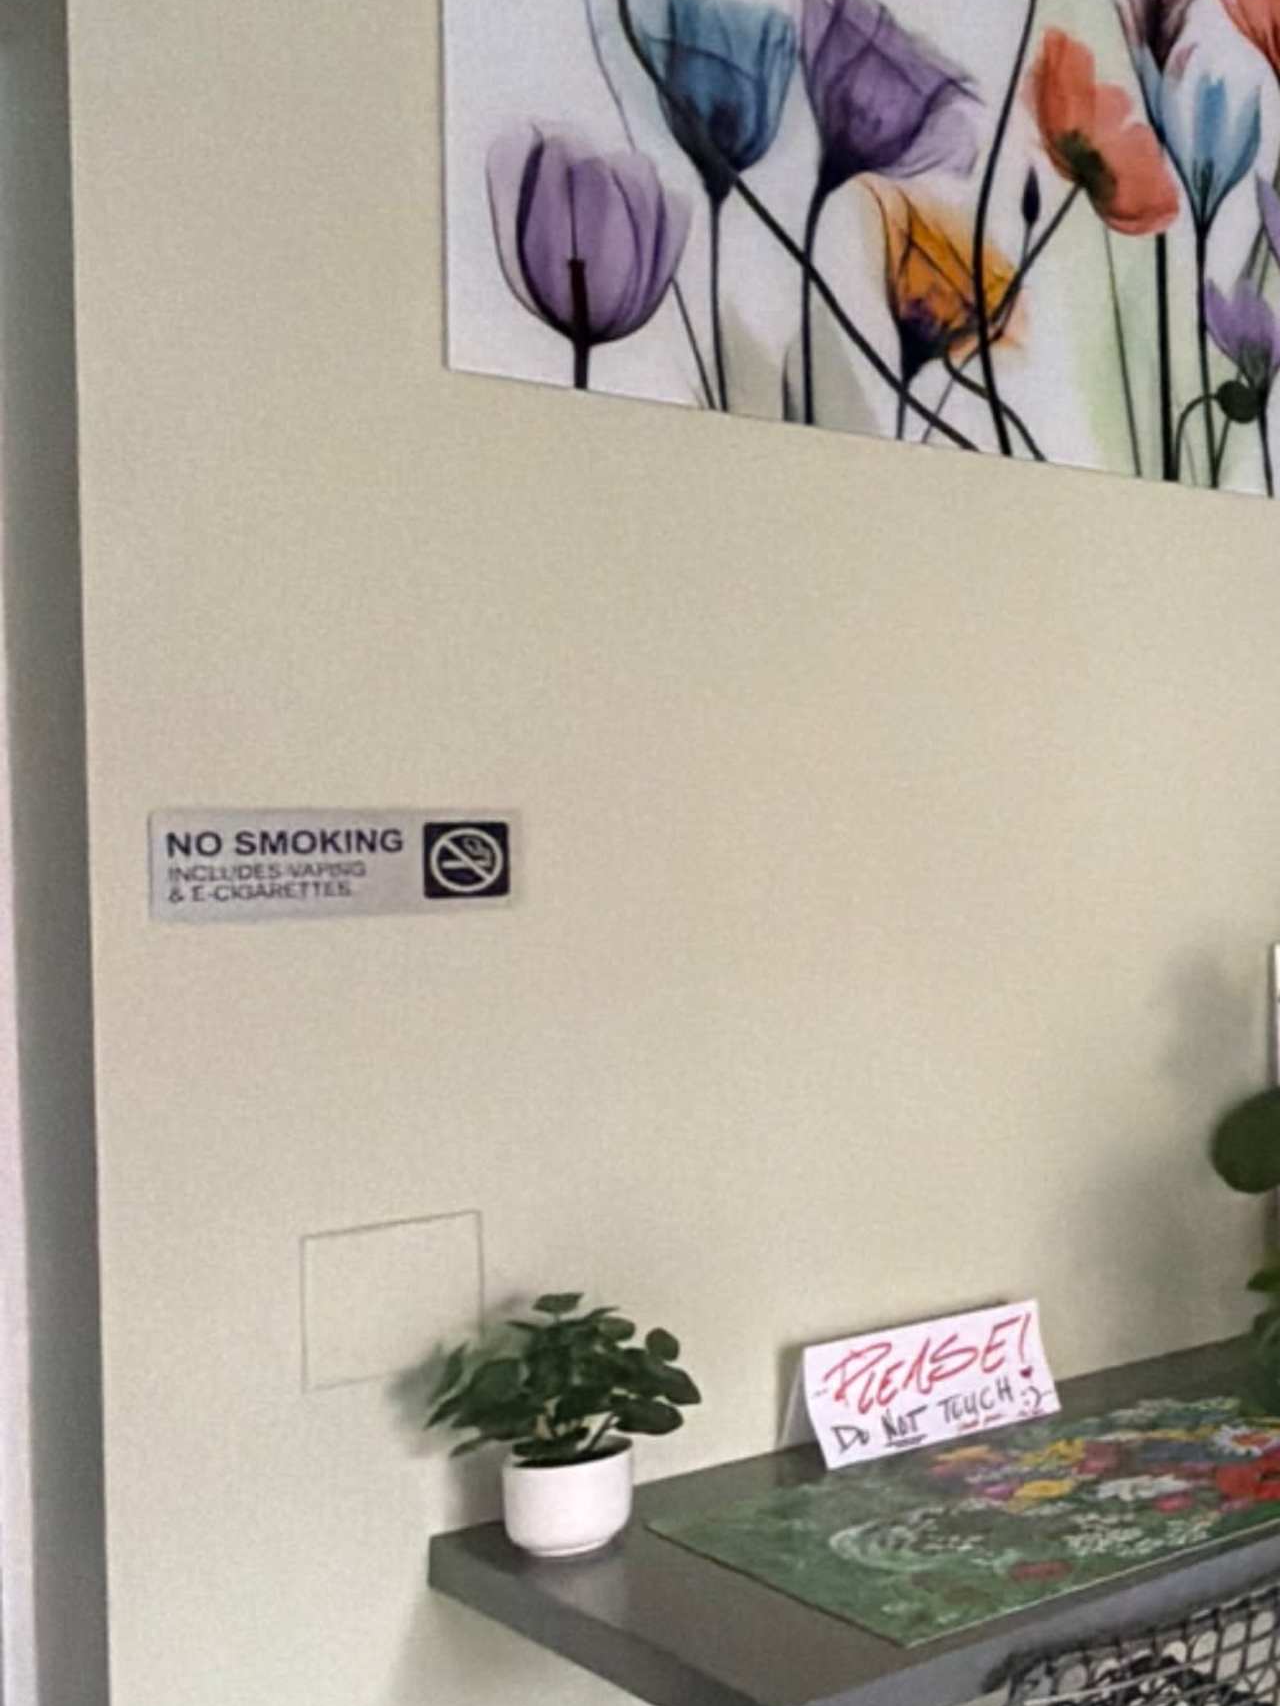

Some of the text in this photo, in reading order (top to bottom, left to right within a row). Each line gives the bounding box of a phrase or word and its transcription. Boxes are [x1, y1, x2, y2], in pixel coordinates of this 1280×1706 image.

[167, 829, 404, 858] NO SMOKING
[168, 861, 367, 883] INCLUDES VAPING
